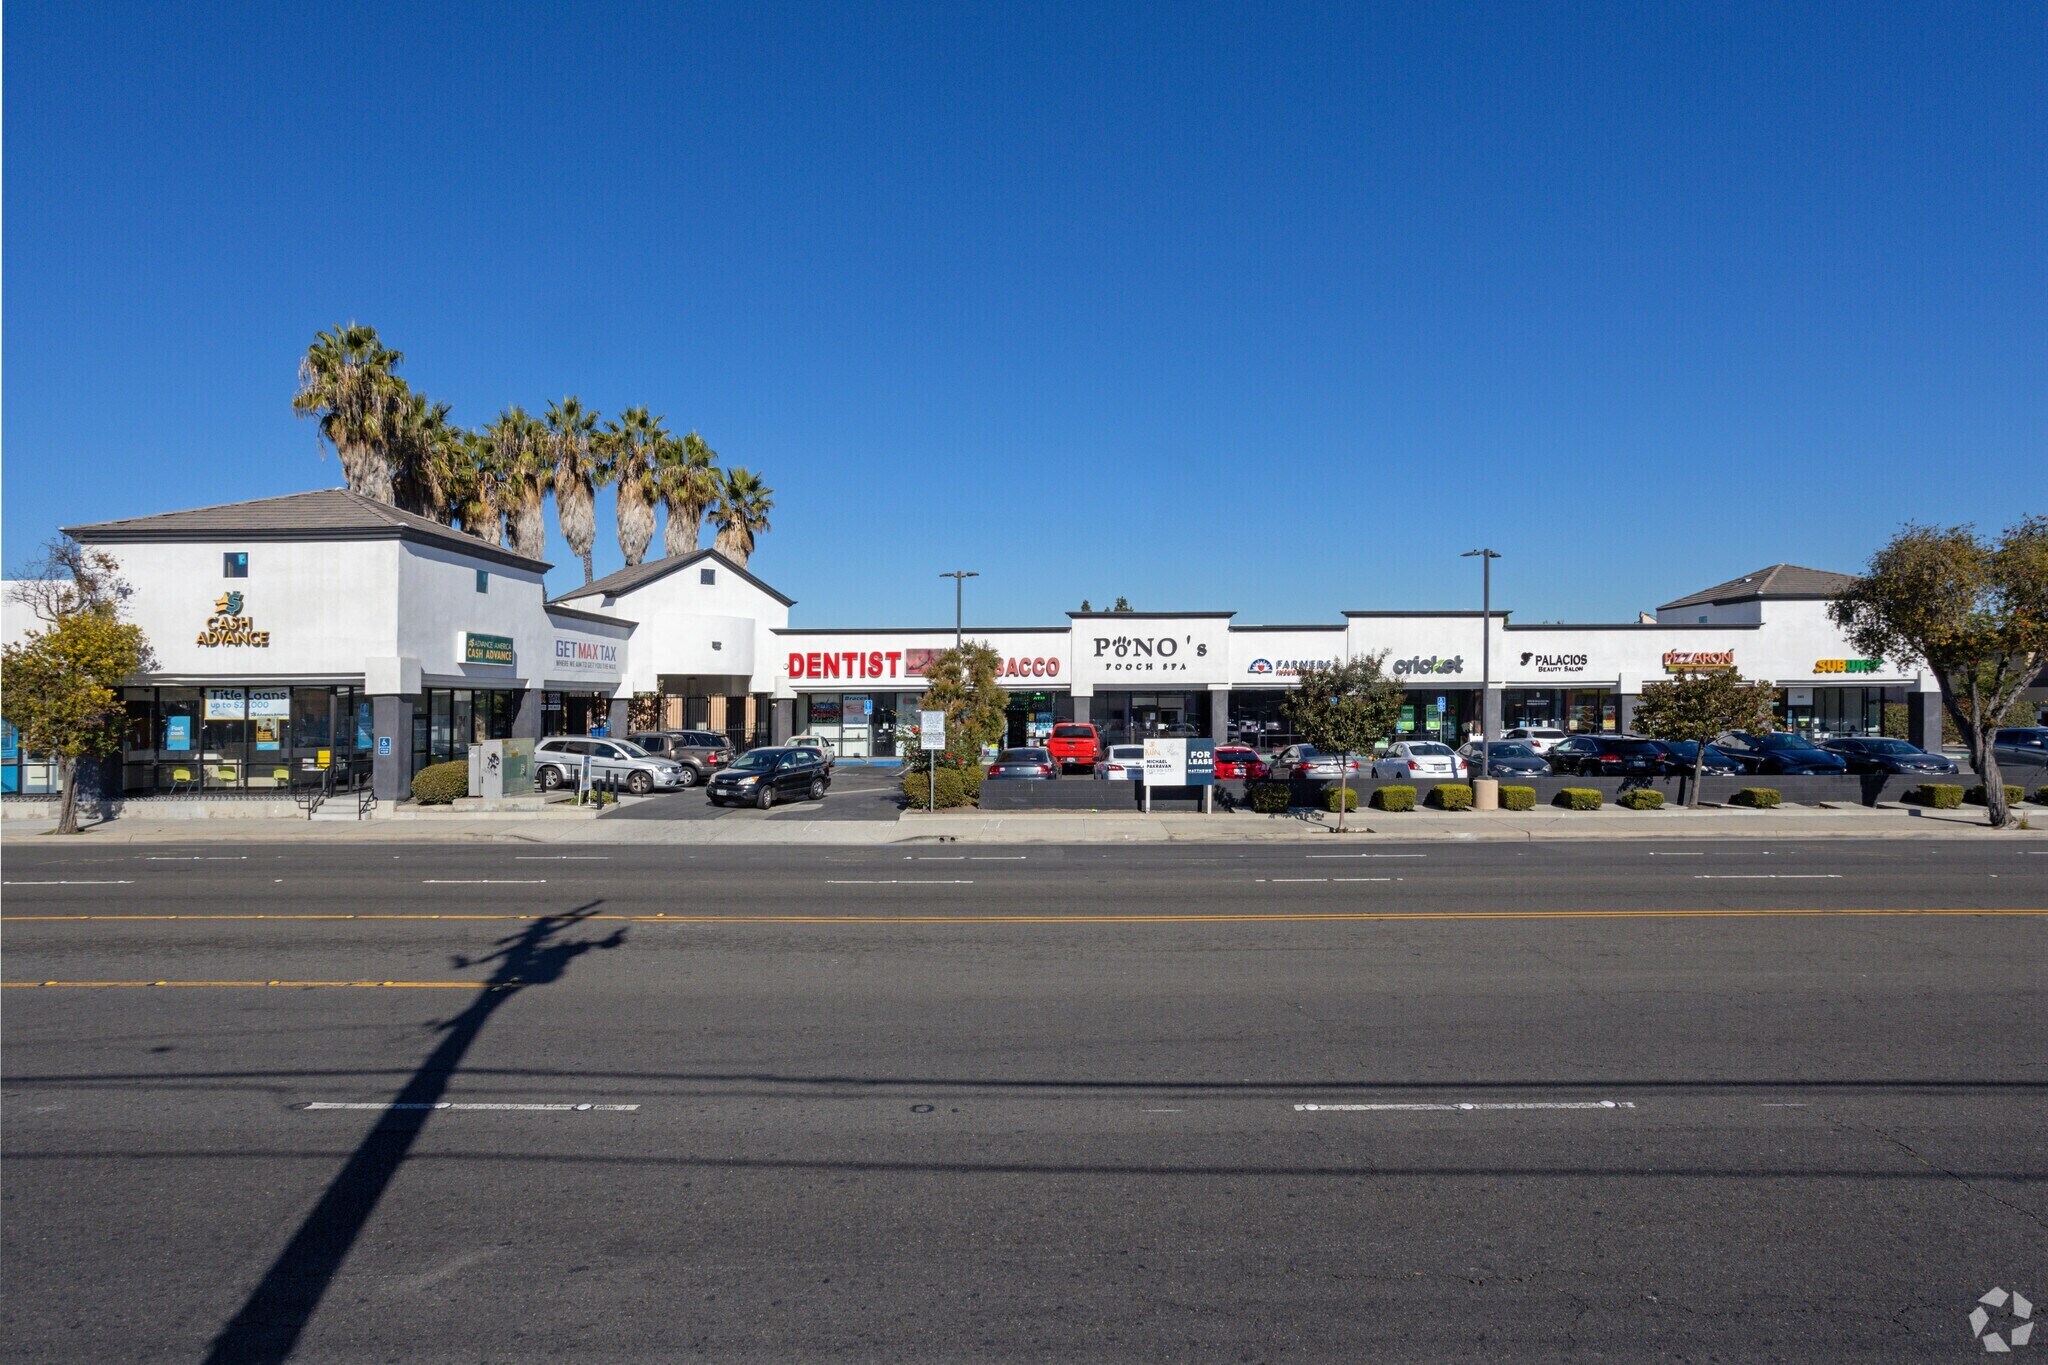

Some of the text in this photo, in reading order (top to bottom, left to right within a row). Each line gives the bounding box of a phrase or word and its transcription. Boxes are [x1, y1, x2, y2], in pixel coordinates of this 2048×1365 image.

[206, 616, 253, 632] CASH
[196, 631, 269, 648] ADVANCE
[474, 640, 512, 650] ADVANCE AMERICA
[467, 648, 512, 661] CASH ADVANCE
[556, 640, 617, 662] GET MAX TAX
[788, 651, 902, 679] DENTIST
[1276, 660, 1332, 670] FARMERS
[1392, 655, 1464, 675] cricket
[1535, 654, 1588, 666] PALACIOS
[993, 657, 1060, 677] BACCO
[1105, 663, 1187, 671] POOCH SPA
[210, 689, 287, 700] Title Loans
[210, 702, 221, 710] up
[222, 701, 232, 709] to
[1190, 751, 1211, 759] FOR
